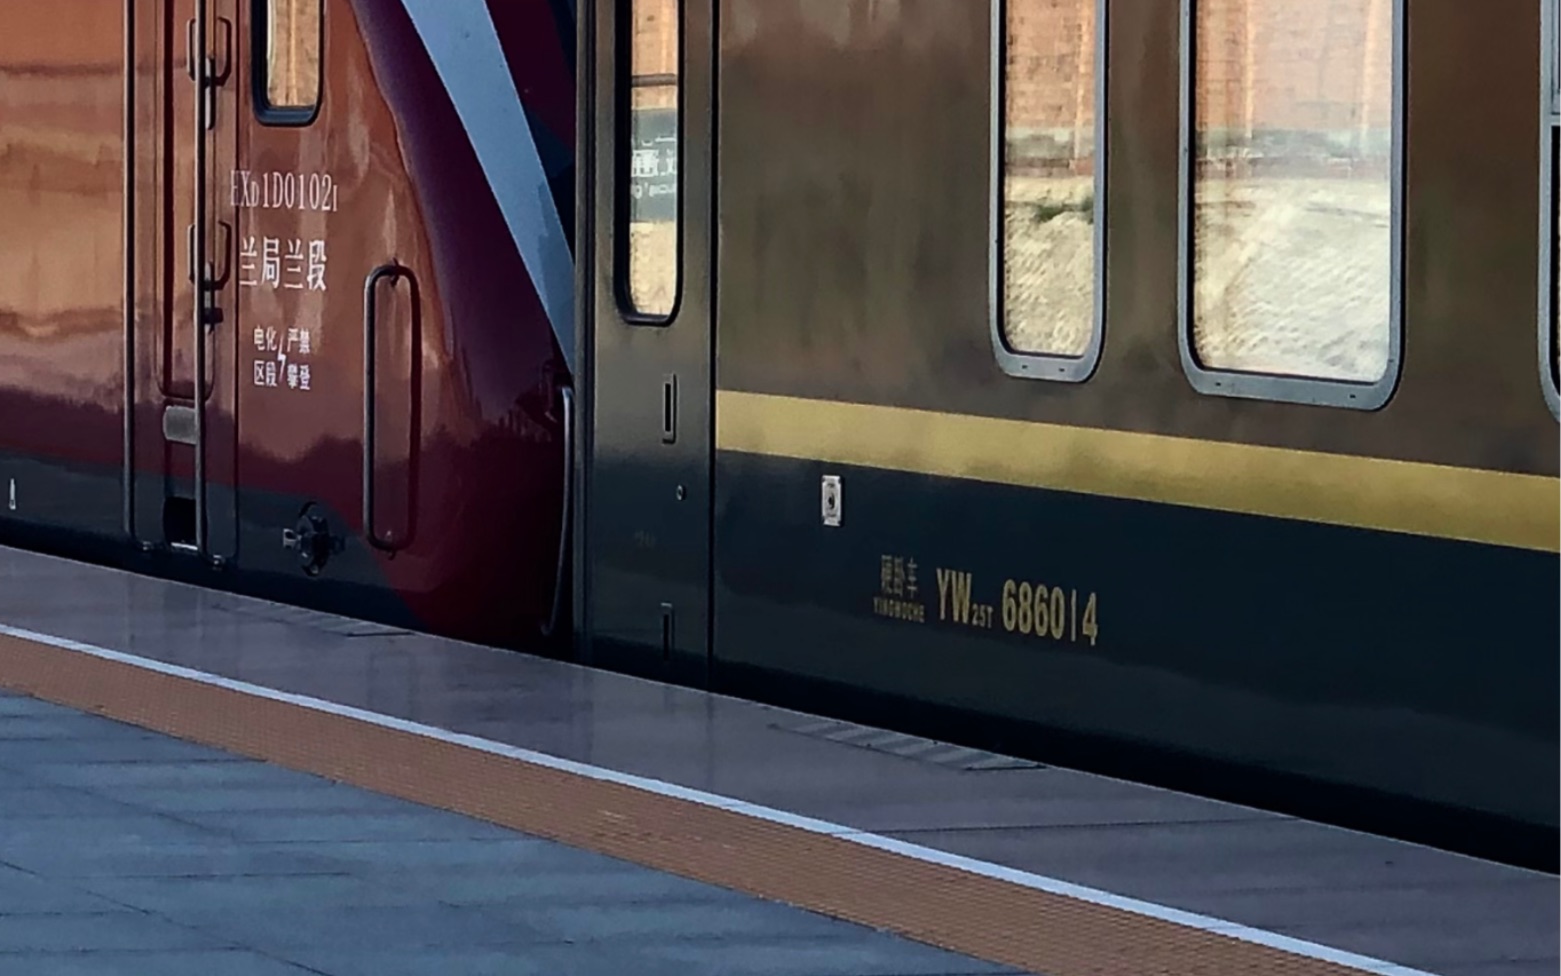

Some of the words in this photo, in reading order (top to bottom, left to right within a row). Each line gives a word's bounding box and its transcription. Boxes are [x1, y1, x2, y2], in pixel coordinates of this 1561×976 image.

[239, 235, 327, 291] 兰局兰段
[253, 325, 277, 351] 电化
[287, 327, 310, 354] 严禁
[253, 360, 277, 387] 区段
[1002, 579, 1098, 646] 686014
